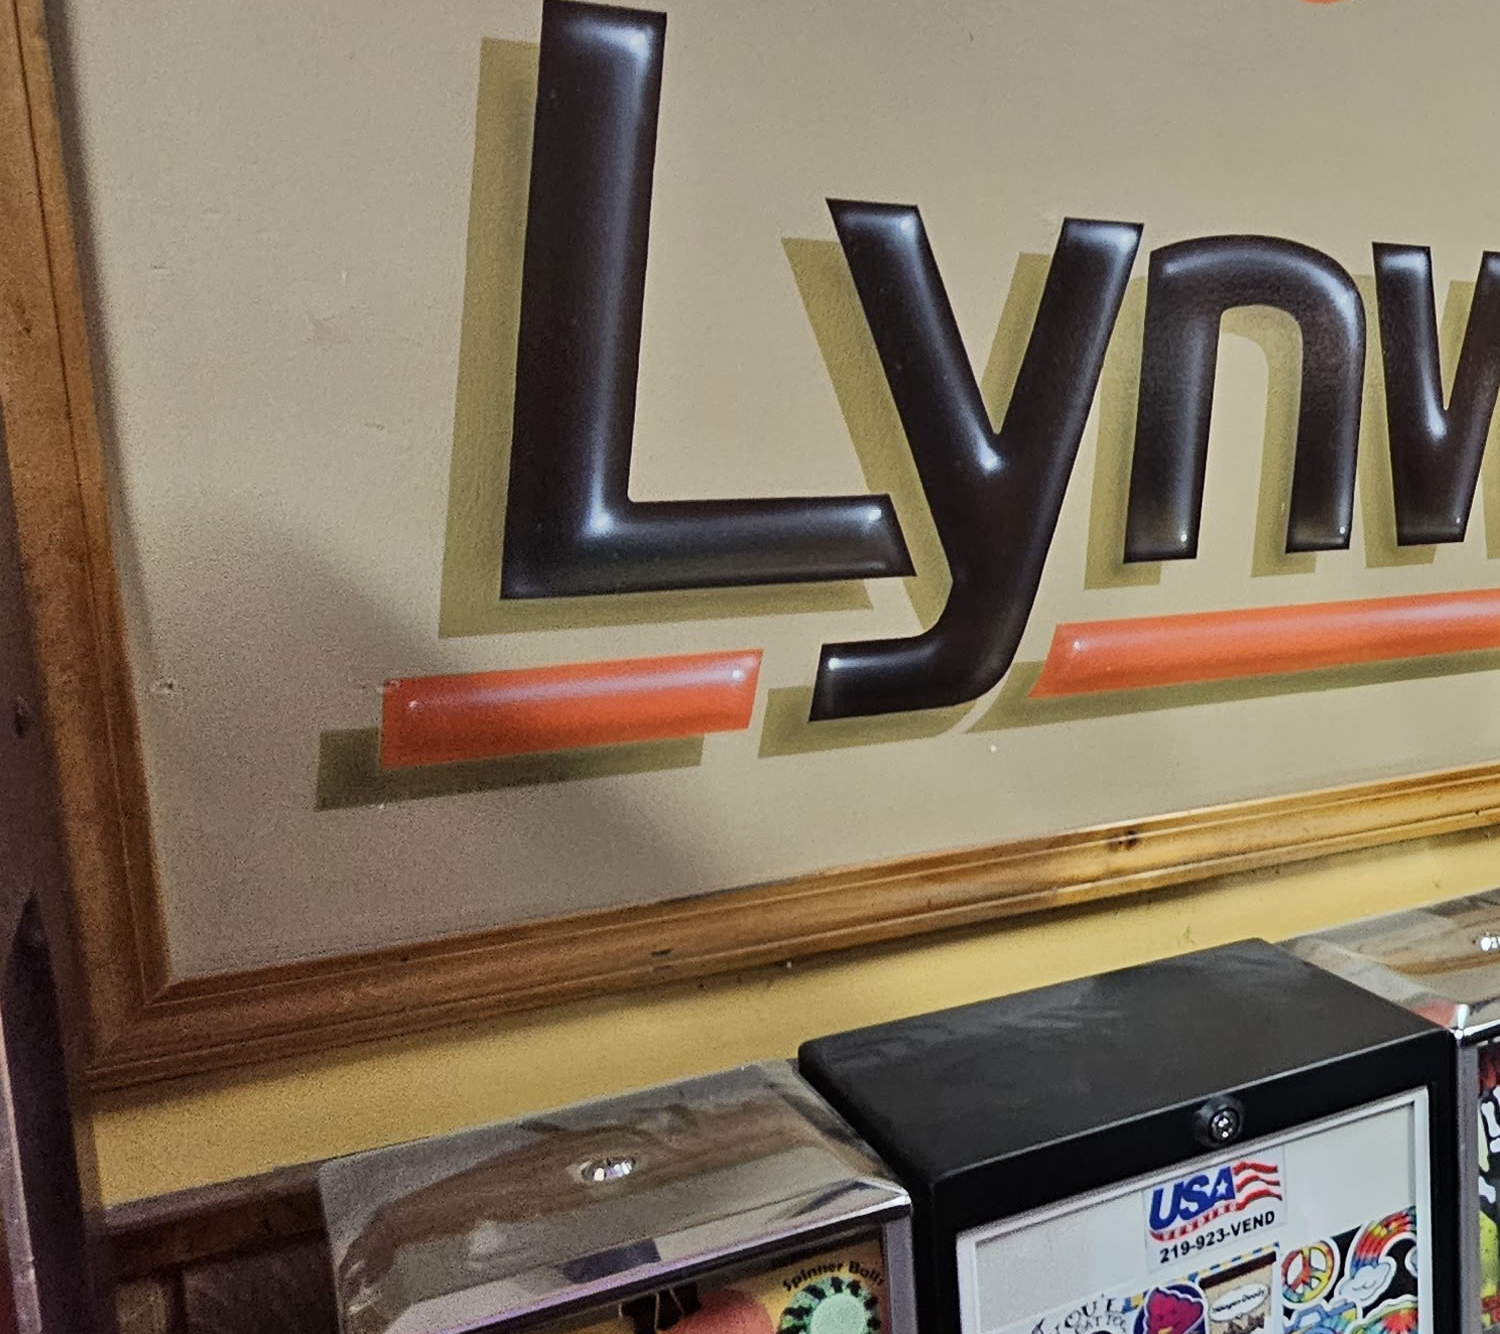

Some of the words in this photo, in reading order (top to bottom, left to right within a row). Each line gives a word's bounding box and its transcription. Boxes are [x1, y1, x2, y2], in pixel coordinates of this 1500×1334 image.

[1149, 1166, 1236, 1231] USA
[1160, 1210, 1276, 1264] 219-923-VEND
[782, 1261, 843, 1292] Spinner
